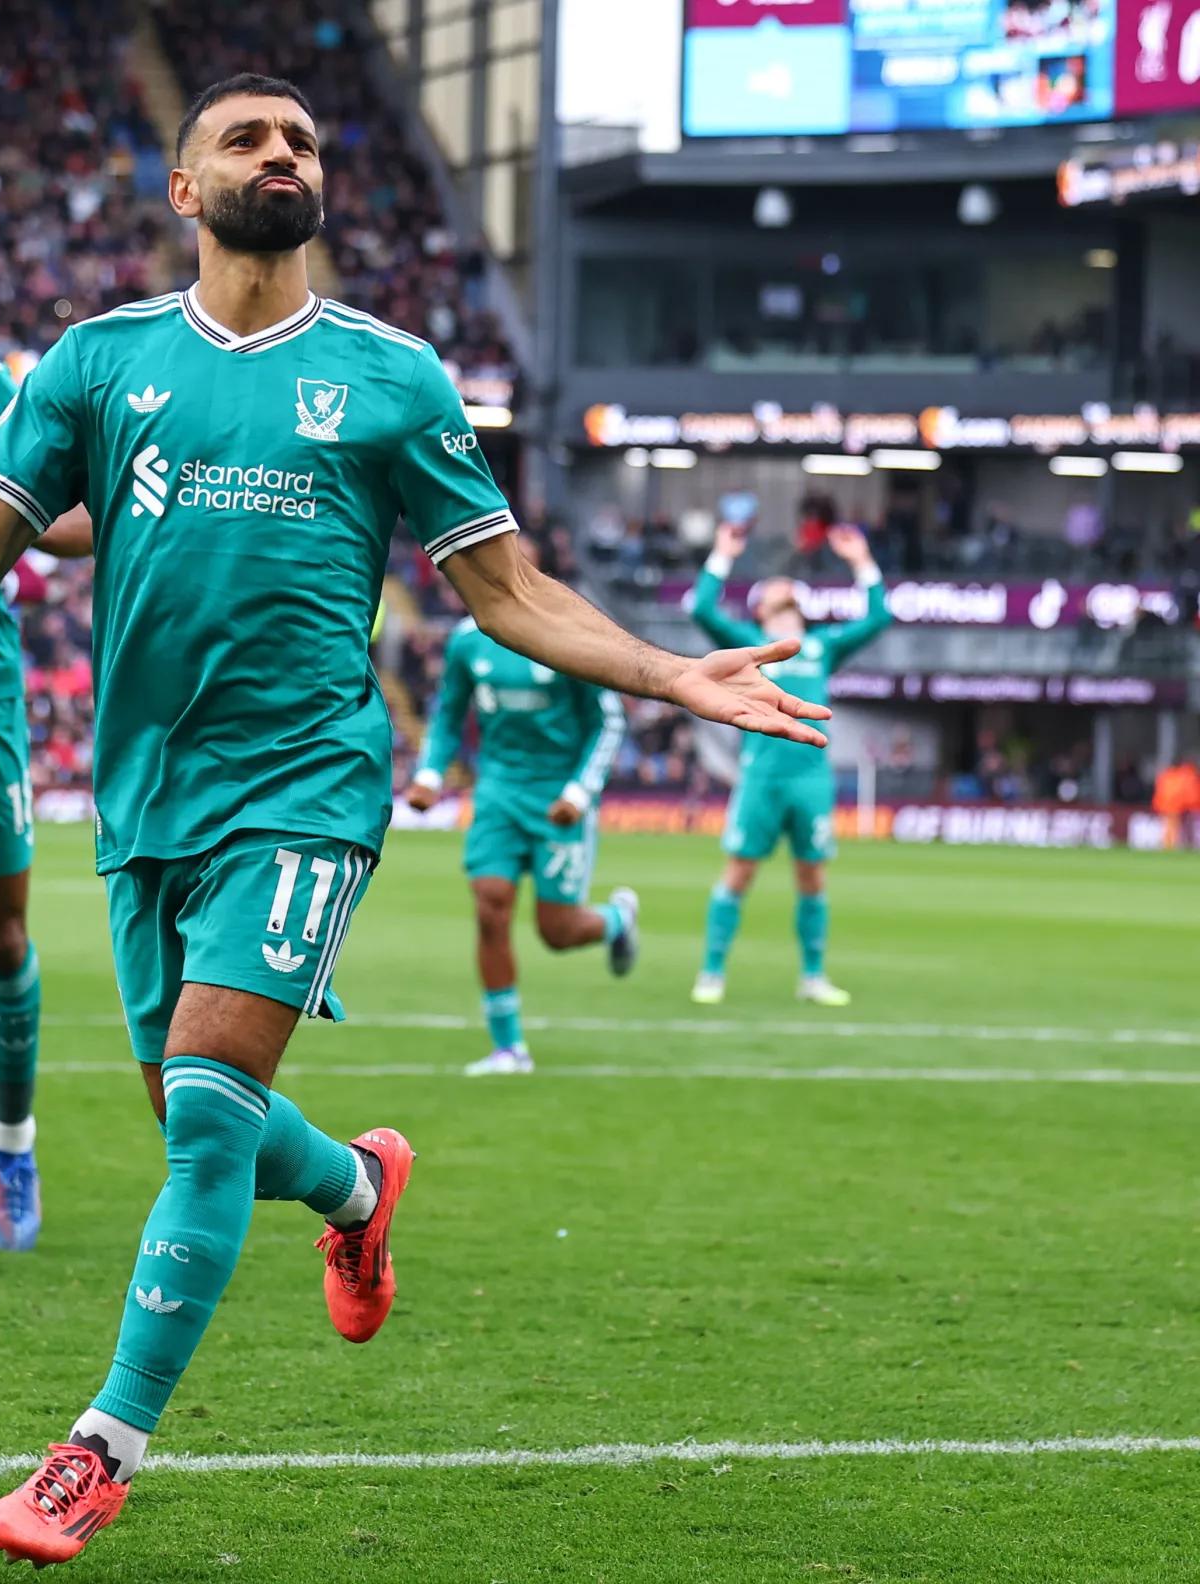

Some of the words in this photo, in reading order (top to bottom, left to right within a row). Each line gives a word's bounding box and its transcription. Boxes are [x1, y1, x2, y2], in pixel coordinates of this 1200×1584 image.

[179, 459, 314, 495] standard
[177, 484, 317, 520] chartered
[266, 848, 337, 944] 11
[143, 1239, 190, 1264] LFC
